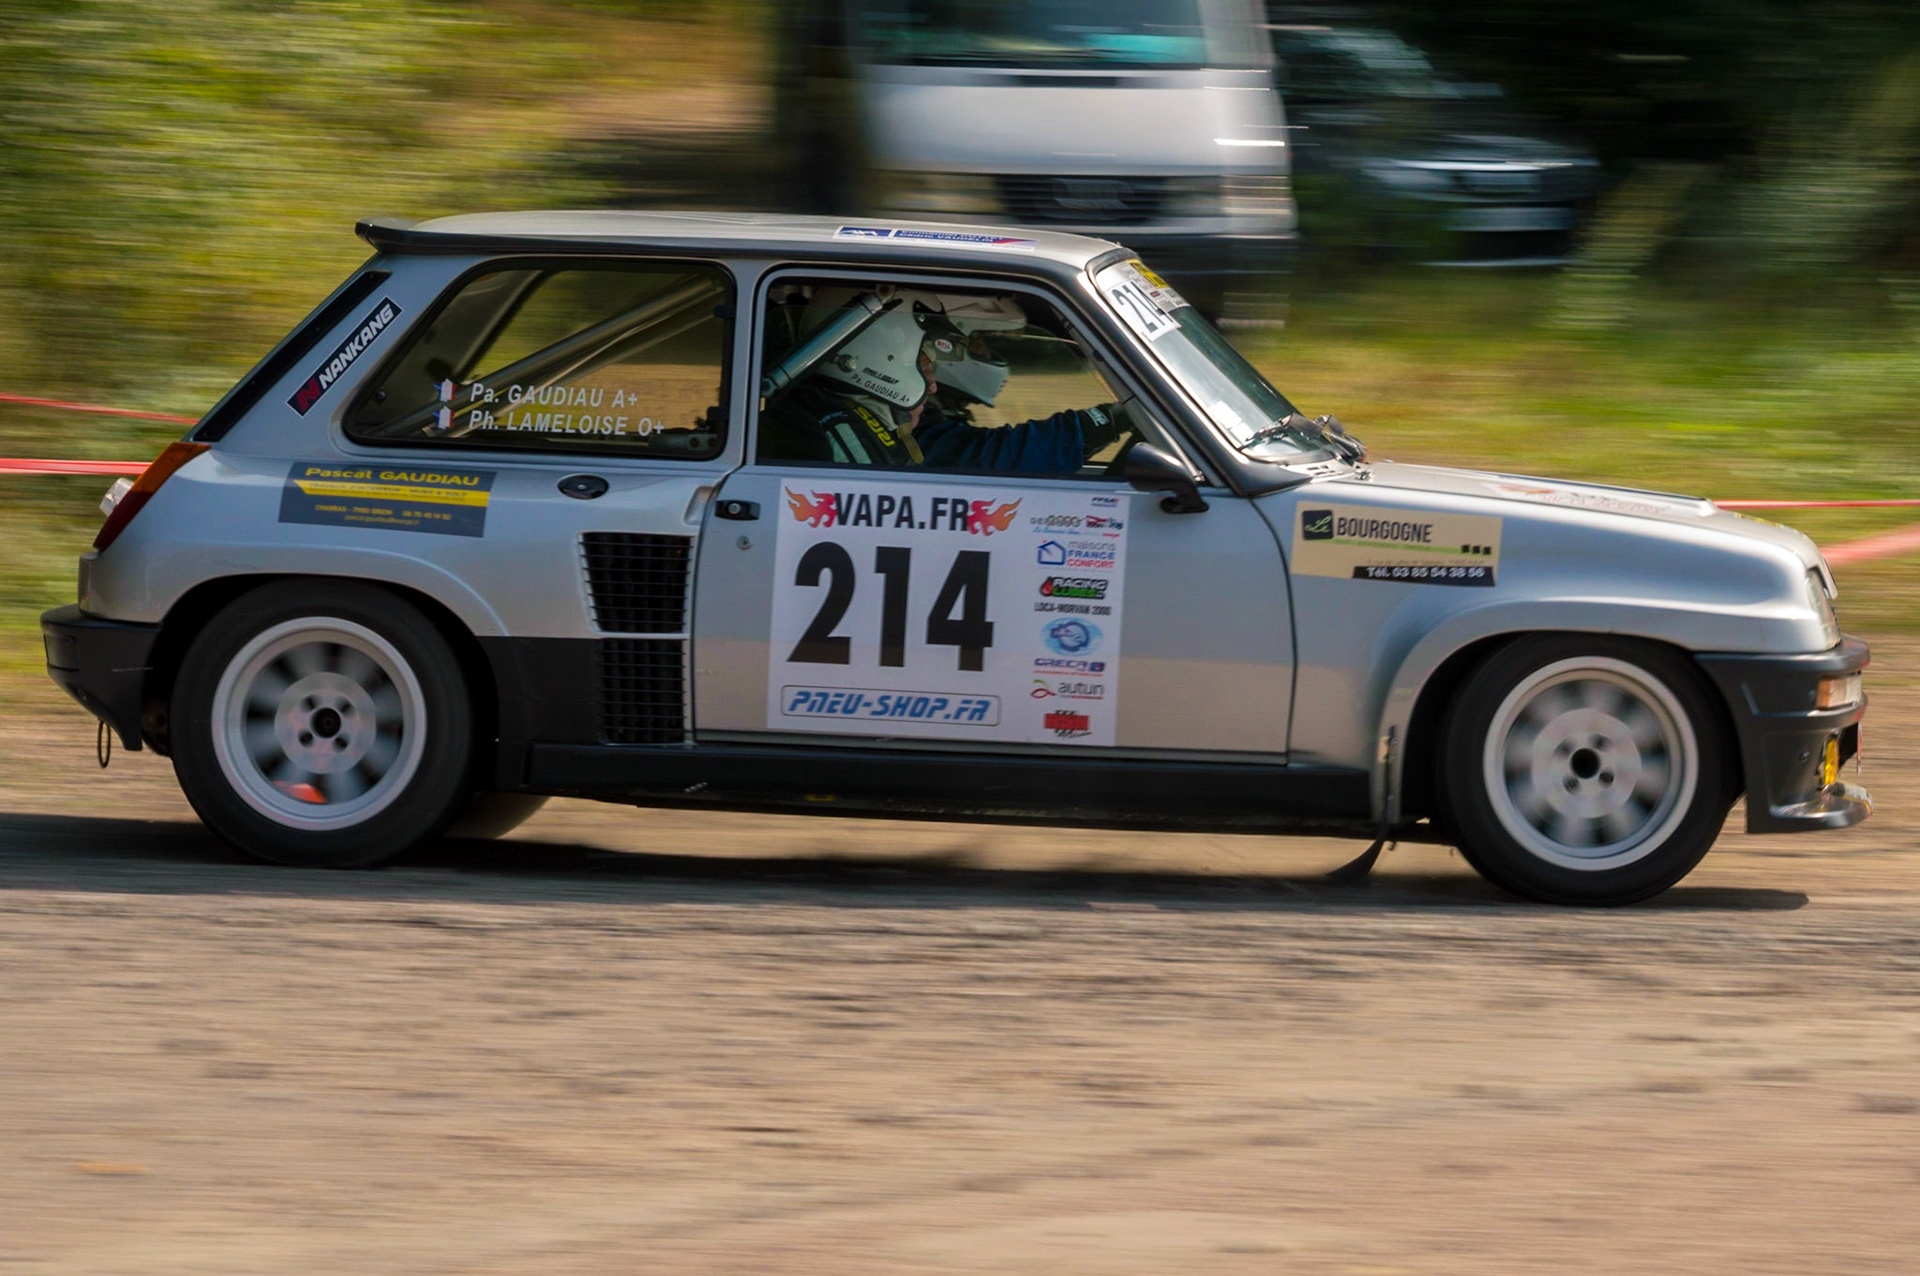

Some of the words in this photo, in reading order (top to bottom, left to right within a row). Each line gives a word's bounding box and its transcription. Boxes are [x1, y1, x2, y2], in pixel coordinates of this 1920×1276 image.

[319, 303, 394, 389] NANKANG
[470, 383, 499, 403] Pa.
[508, 384, 604, 407] GAUDIAU
[611, 389, 638, 408] A+
[864, 380, 900, 400] GAUDIAU
[468, 410, 499, 430] Ph.
[507, 412, 628, 436] LAMELOISE
[305, 467, 372, 480] Pascal
[379, 470, 480, 486] GAUDIAU
[834, 492, 968, 532] VAPA.FR
[1336, 517, 1434, 543] BOURGOGNE
[1067, 540, 1116, 552] maisons
[1067, 550, 1115, 560] FRANCE
[1067, 558, 1115, 569] CONFORT
[1052, 577, 1109, 591] RACING
[786, 541, 995, 672] 214
[1058, 682, 1105, 695] autun
[788, 690, 992, 722] PNEU-SHOP.FR
